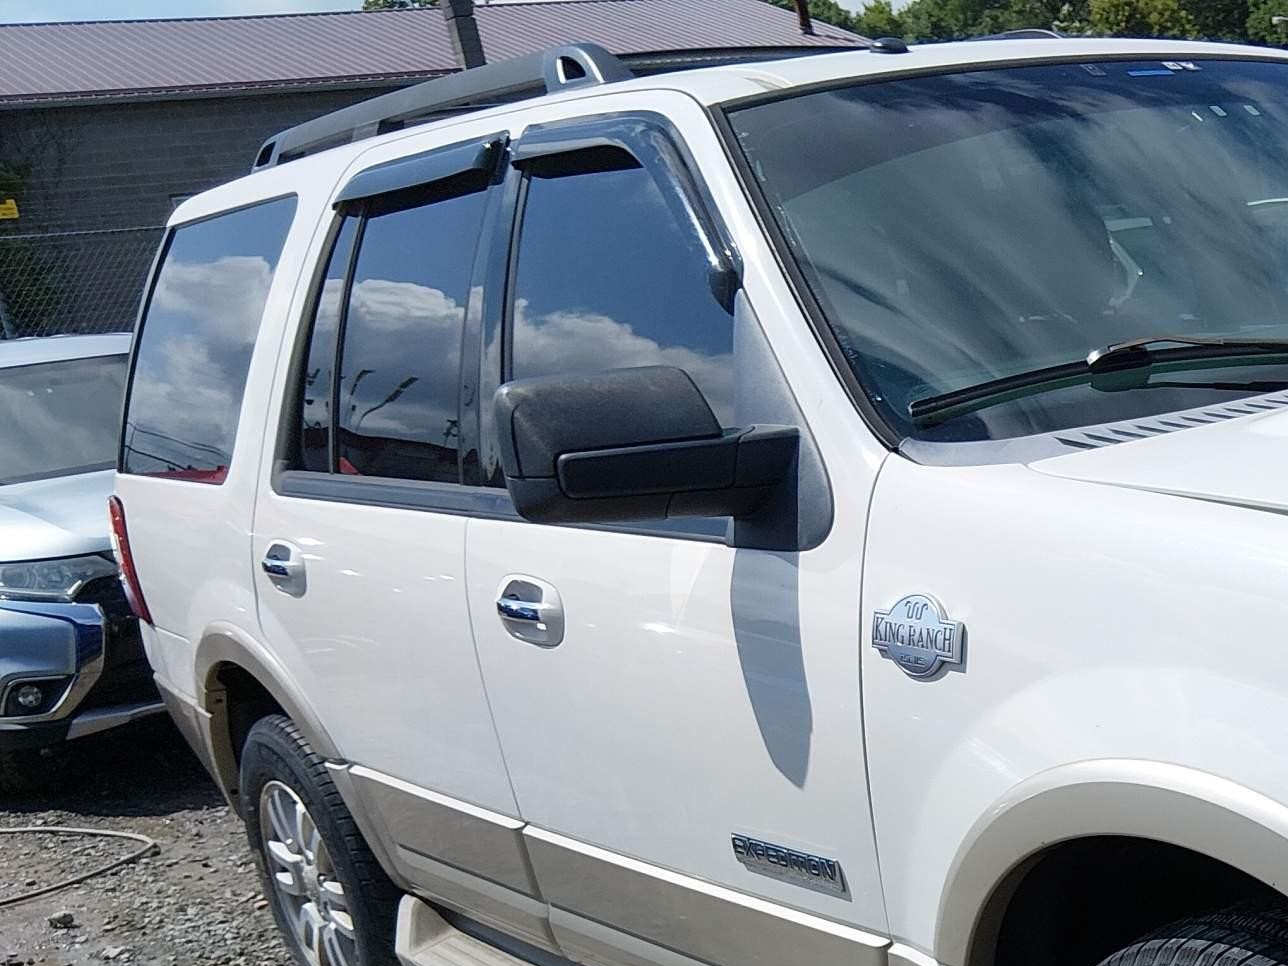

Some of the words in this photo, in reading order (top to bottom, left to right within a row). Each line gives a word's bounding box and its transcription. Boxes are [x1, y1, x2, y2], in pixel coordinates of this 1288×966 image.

[874, 616, 905, 647] KING
[908, 624, 954, 653] RANCH
[731, 834, 839, 882] EXPEDITION
